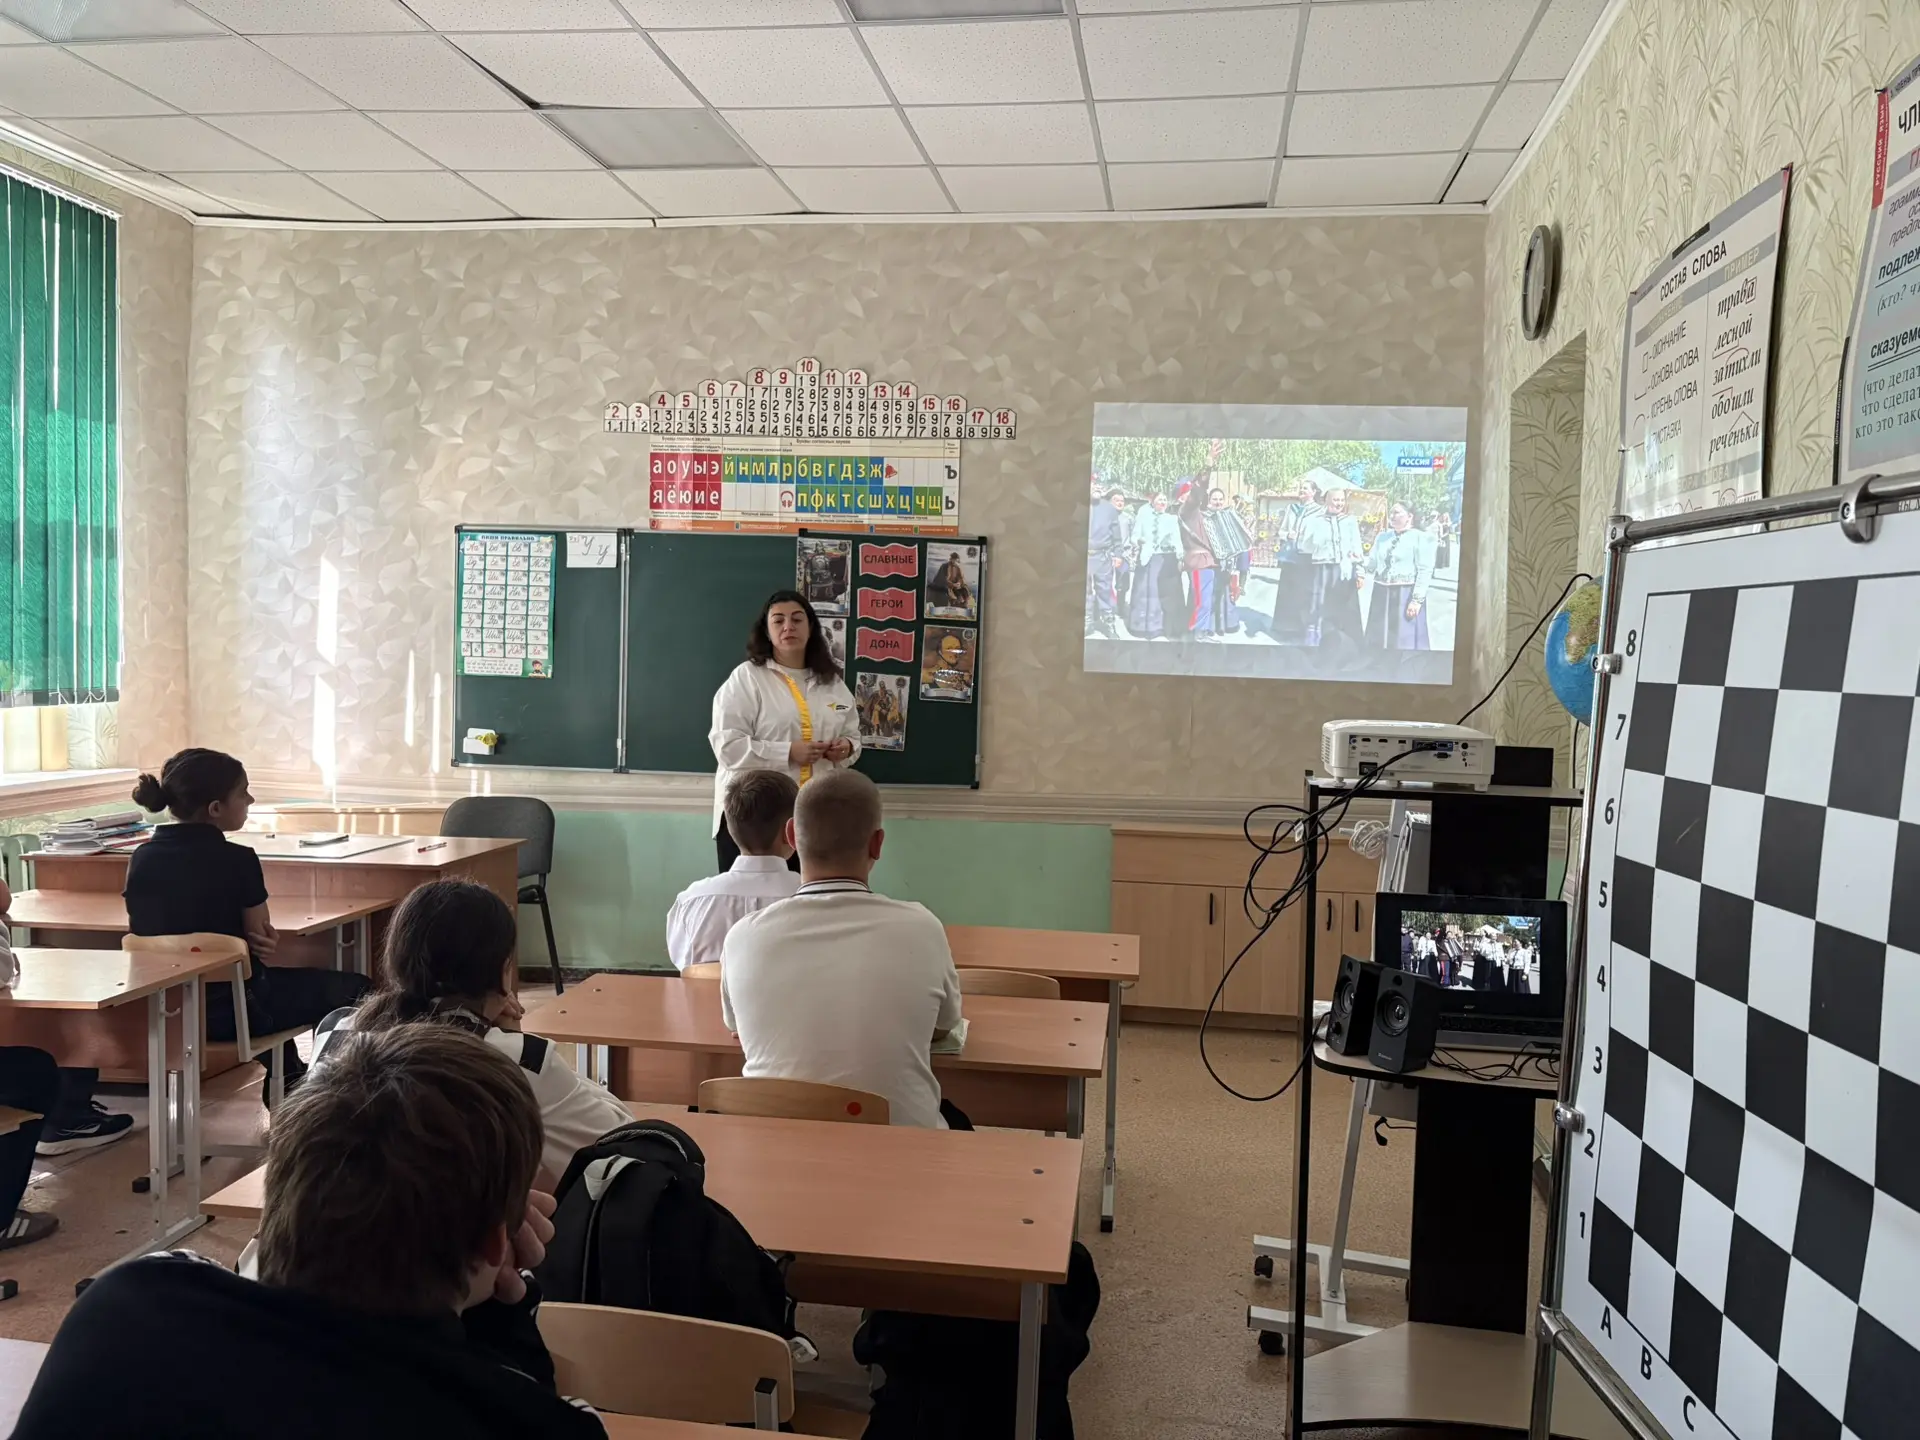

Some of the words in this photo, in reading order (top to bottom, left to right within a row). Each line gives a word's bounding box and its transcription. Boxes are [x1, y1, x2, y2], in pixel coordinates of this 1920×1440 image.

[1898, 100, 1920, 134] ЧЛ
[1875, 138, 1883, 186] РУССКИЙ
[1724, 247, 1760, 282] ПРИМЕР
[1660, 266, 1687, 302] СОСТАВ
[1692, 241, 1727, 276] СЛОВА
[1717, 278, 1755, 319] трава
[1714, 313, 1753, 351] лесной
[800, 360, 813, 373] 10
[1712, 348, 1762, 386] затихли
[755, 371, 763, 384] 8
[779, 371, 787, 384] 9
[809, 376, 817, 387] 9
[825, 372, 836, 385] 11
[848, 372, 862, 385] 12
[707, 383, 715, 396] 6
[729, 383, 738, 396] 7
[797, 388, 805, 399] 2
[809, 388, 817, 399] 8
[874, 385, 887, 398] 13
[897, 385, 911, 398] 14
[658, 395, 666, 408] 4
[682, 395, 691, 408] 5
[712, 398, 720, 409] 5
[736, 398, 744, 409] 6
[797, 401, 805, 412] 3
[809, 401, 817, 412] 7
[922, 398, 936, 411] 15
[947, 398, 960, 411] 16
[1711, 388, 1754, 420] обошли
[611, 405, 620, 418] 2
[634, 404, 643, 417] 3
[665, 410, 672, 421] 3
[687, 410, 695, 421] 4
[1862, 401, 1880, 417] что
[700, 411, 707, 422] 2
[711, 411, 719, 422] 4
[724, 411, 731, 422] 2
[736, 411, 744, 422] 5
[795, 413, 803, 424] 4
[808, 413, 815, 425] 6
[918, 413, 926, 425] 6
[931, 413, 938, 425] 9
[971, 411, 985, 424] 17
[996, 411, 1010, 424] 18
[641, 421, 648, 432] 2
[652, 422, 660, 433] 2
[664, 422, 672, 433] 2
[676, 422, 683, 433] 2
[688, 422, 695, 433] 3
[700, 423, 707, 434] 3
[711, 423, 719, 434] 3
[723, 423, 731, 434] 3
[735, 423, 743, 434] 4
[795, 426, 803, 437] 5
[808, 426, 815, 437] 5
[918, 426, 926, 437] 7
[931, 426, 938, 437] 8
[967, 427, 975, 438] 8
[980, 427, 988, 438] 9
[993, 427, 1001, 438] 9
[1005, 427, 1013, 438] 9
[1855, 421, 1873, 439] кто
[1876, 416, 1894, 433] это
[1708, 421, 1760, 462] реченька
[1400, 458, 1430, 466] РОССИЯ
[863, 554, 914, 564] СЛАВНЫЕ
[870, 599, 904, 609] ГЕРОИ
[869, 639, 900, 649] ДОНА
[1625, 629, 1637, 657] 8
[1614, 713, 1627, 741] 7
[1604, 797, 1615, 825] 6
[1598, 881, 1608, 908] 5
[1596, 964, 1607, 992] 4
[1593, 1046, 1603, 1074] 3
[1583, 1129, 1594, 1158] 2
[1578, 1211, 1586, 1239] 1
[1600, 1304, 1613, 1340] A
[1640, 1344, 1653, 1380] B
[1682, 1396, 1697, 1432] C
